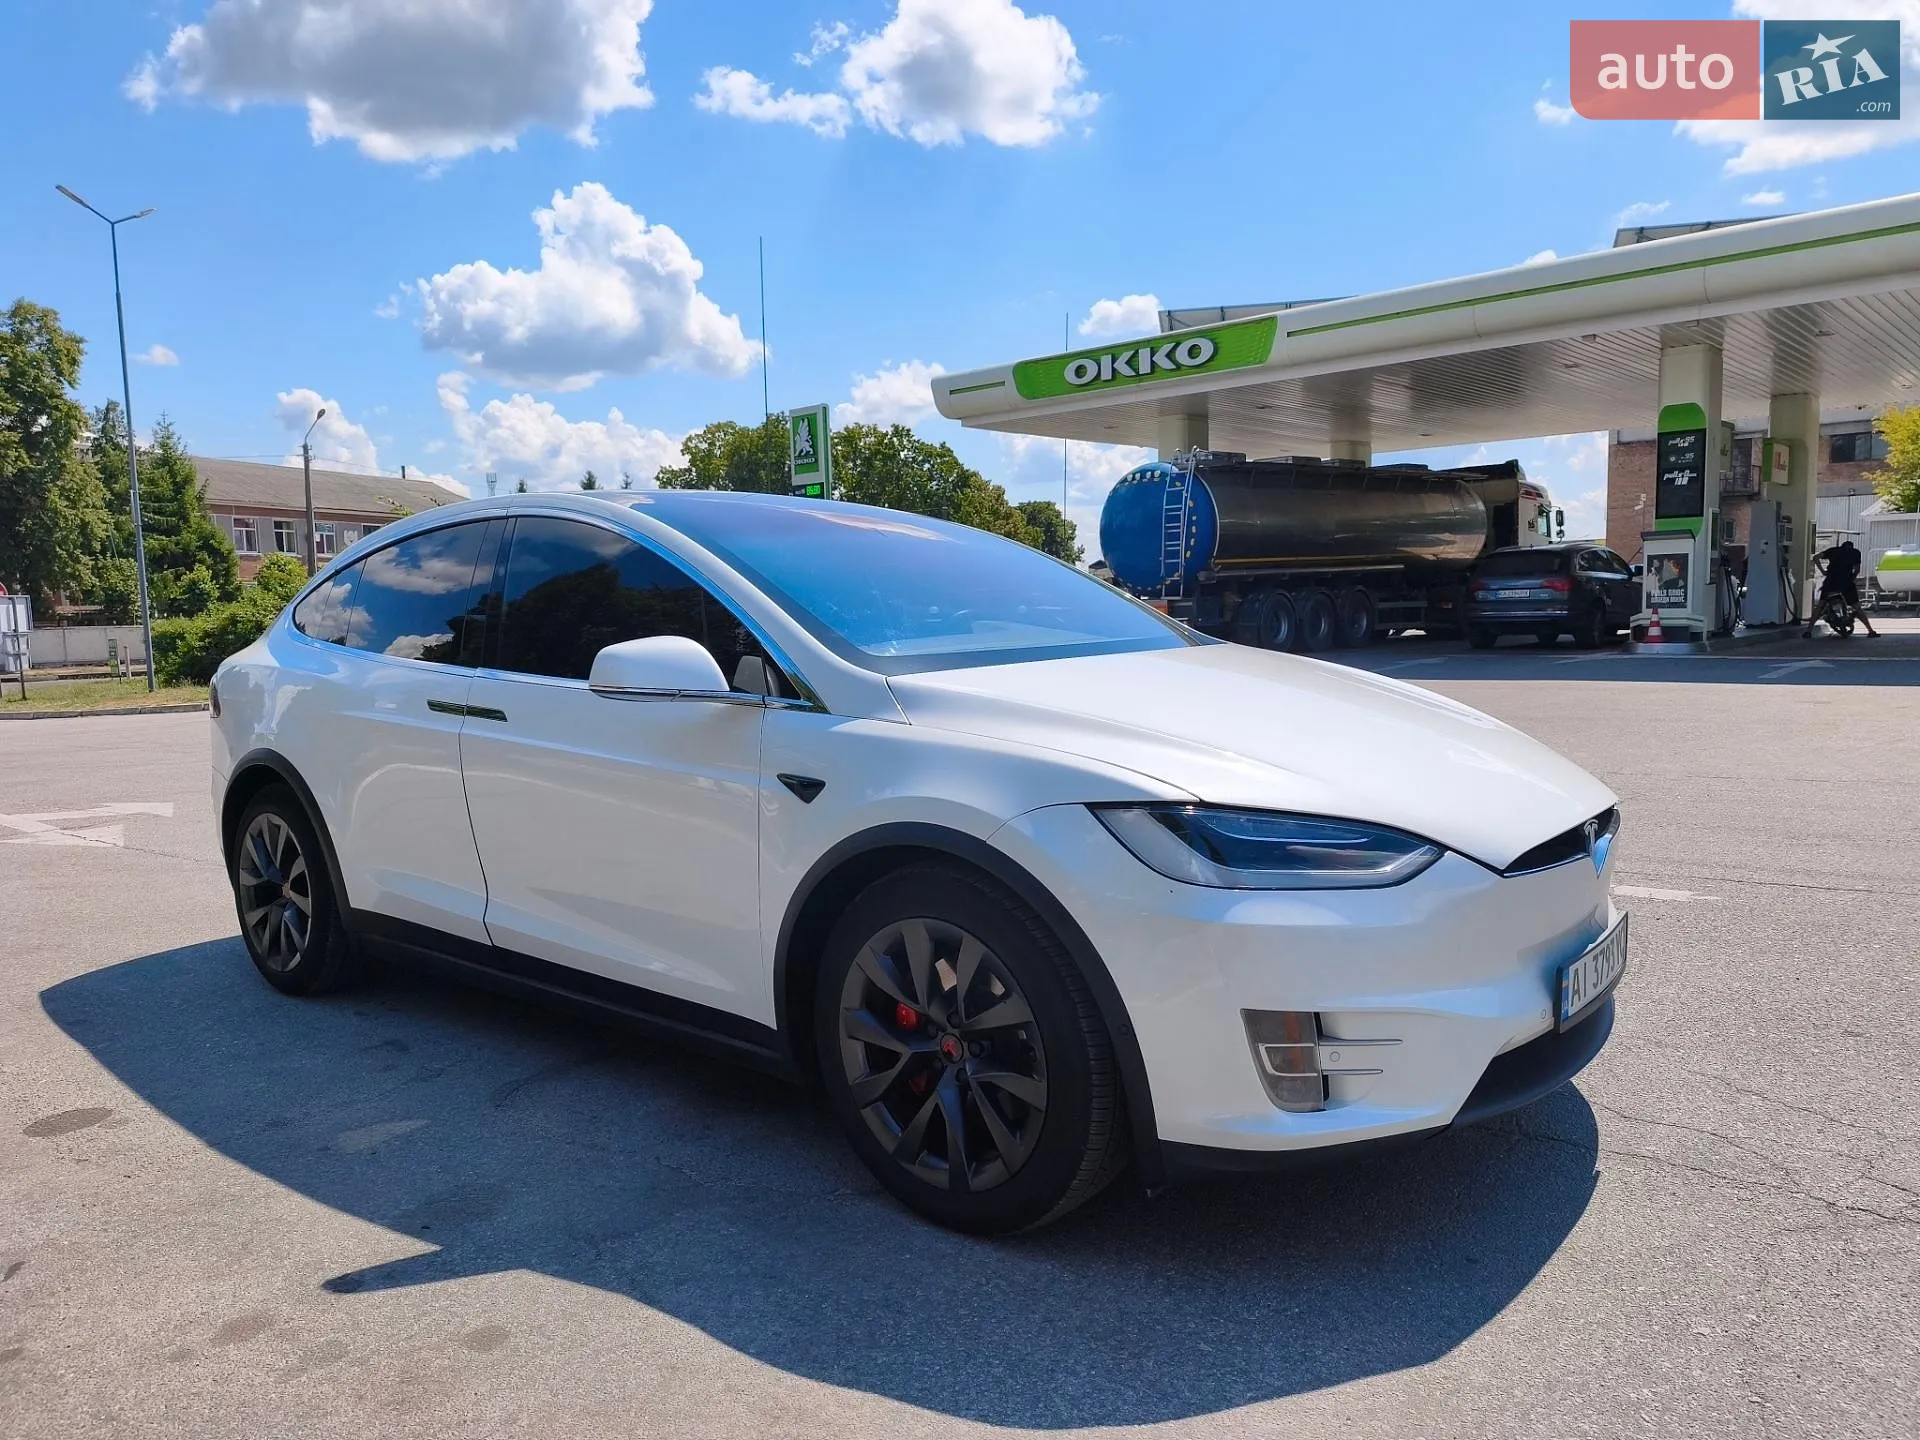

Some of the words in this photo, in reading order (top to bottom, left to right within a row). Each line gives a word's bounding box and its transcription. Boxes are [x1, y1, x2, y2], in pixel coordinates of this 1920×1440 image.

[1063, 337, 1215, 386] OKKO
[1571, 962, 1587, 1008] AI
[1592, 939, 1616, 990] 3793
